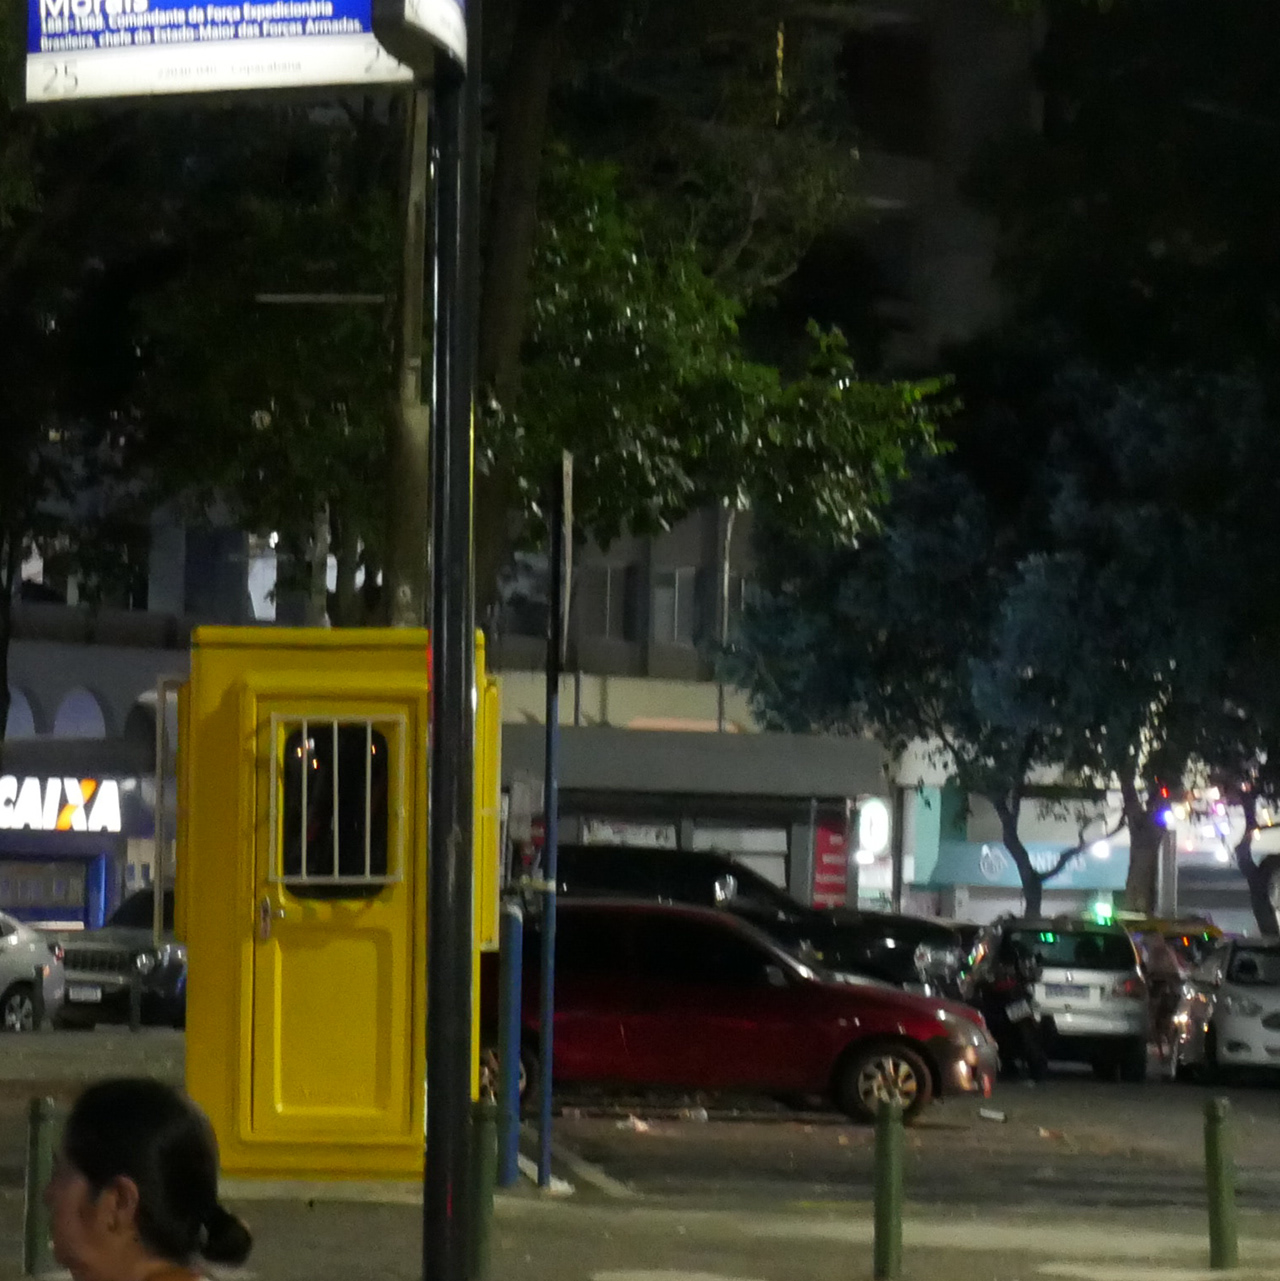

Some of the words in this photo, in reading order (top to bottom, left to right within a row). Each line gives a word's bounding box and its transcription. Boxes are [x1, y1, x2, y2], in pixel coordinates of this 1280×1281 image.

[108, 8, 186, 30] Comandante
[99, 29, 132, 48] chefe
[134, 28, 151, 45] do
[42, 60, 79, 95] 25
